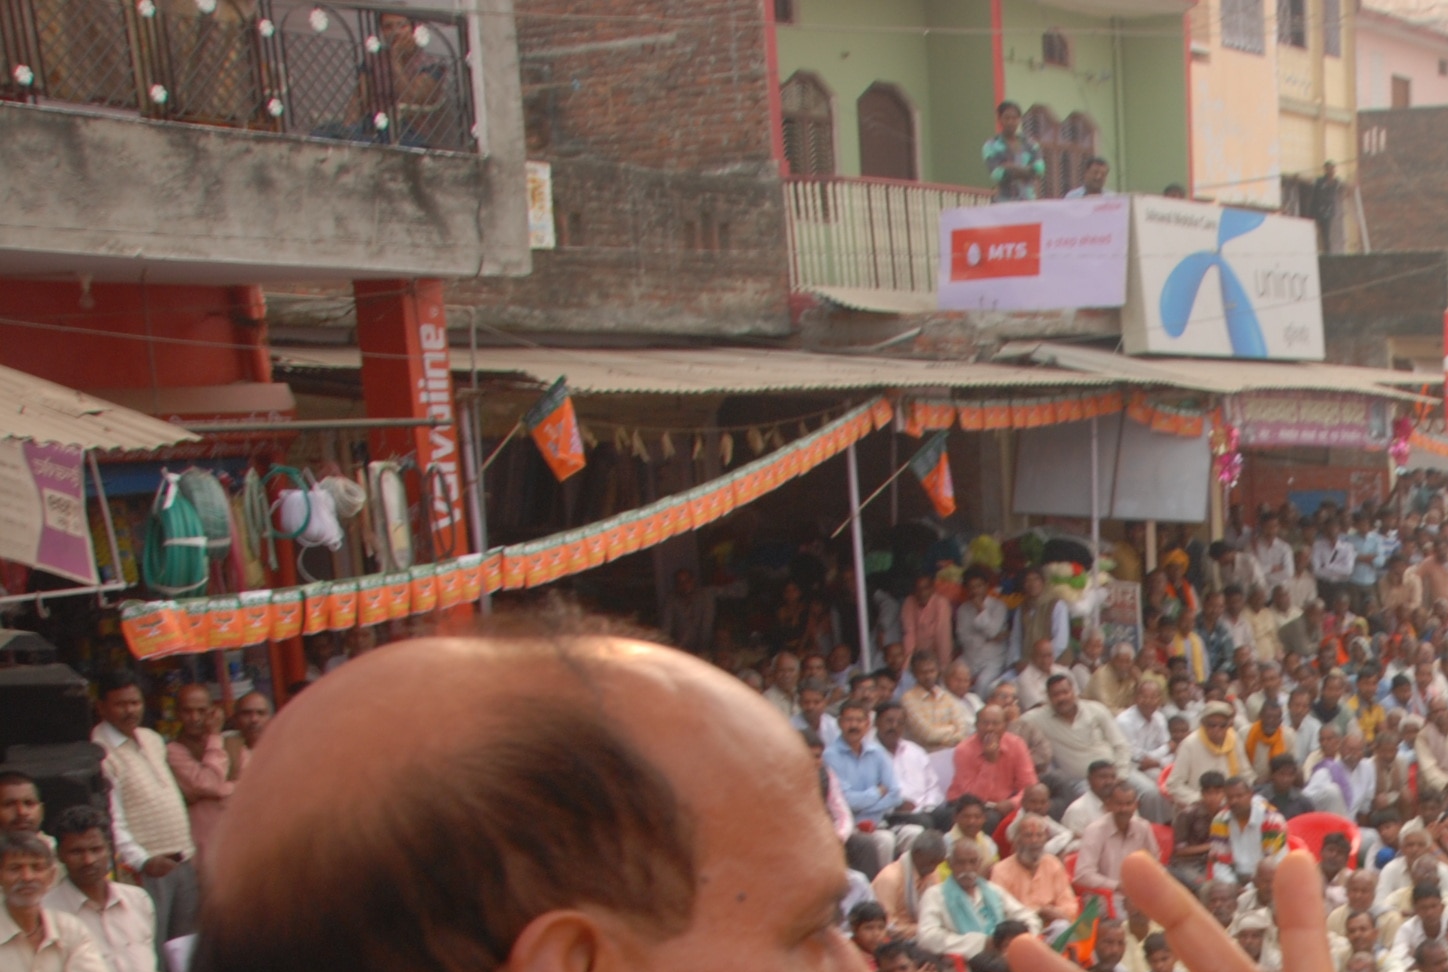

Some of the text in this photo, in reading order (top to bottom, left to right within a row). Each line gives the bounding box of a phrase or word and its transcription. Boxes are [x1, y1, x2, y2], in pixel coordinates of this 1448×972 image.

[1079, 233, 1113, 246] ahead
[988, 242, 1028, 261] MTS
[1254, 262, 1310, 301] uninor
